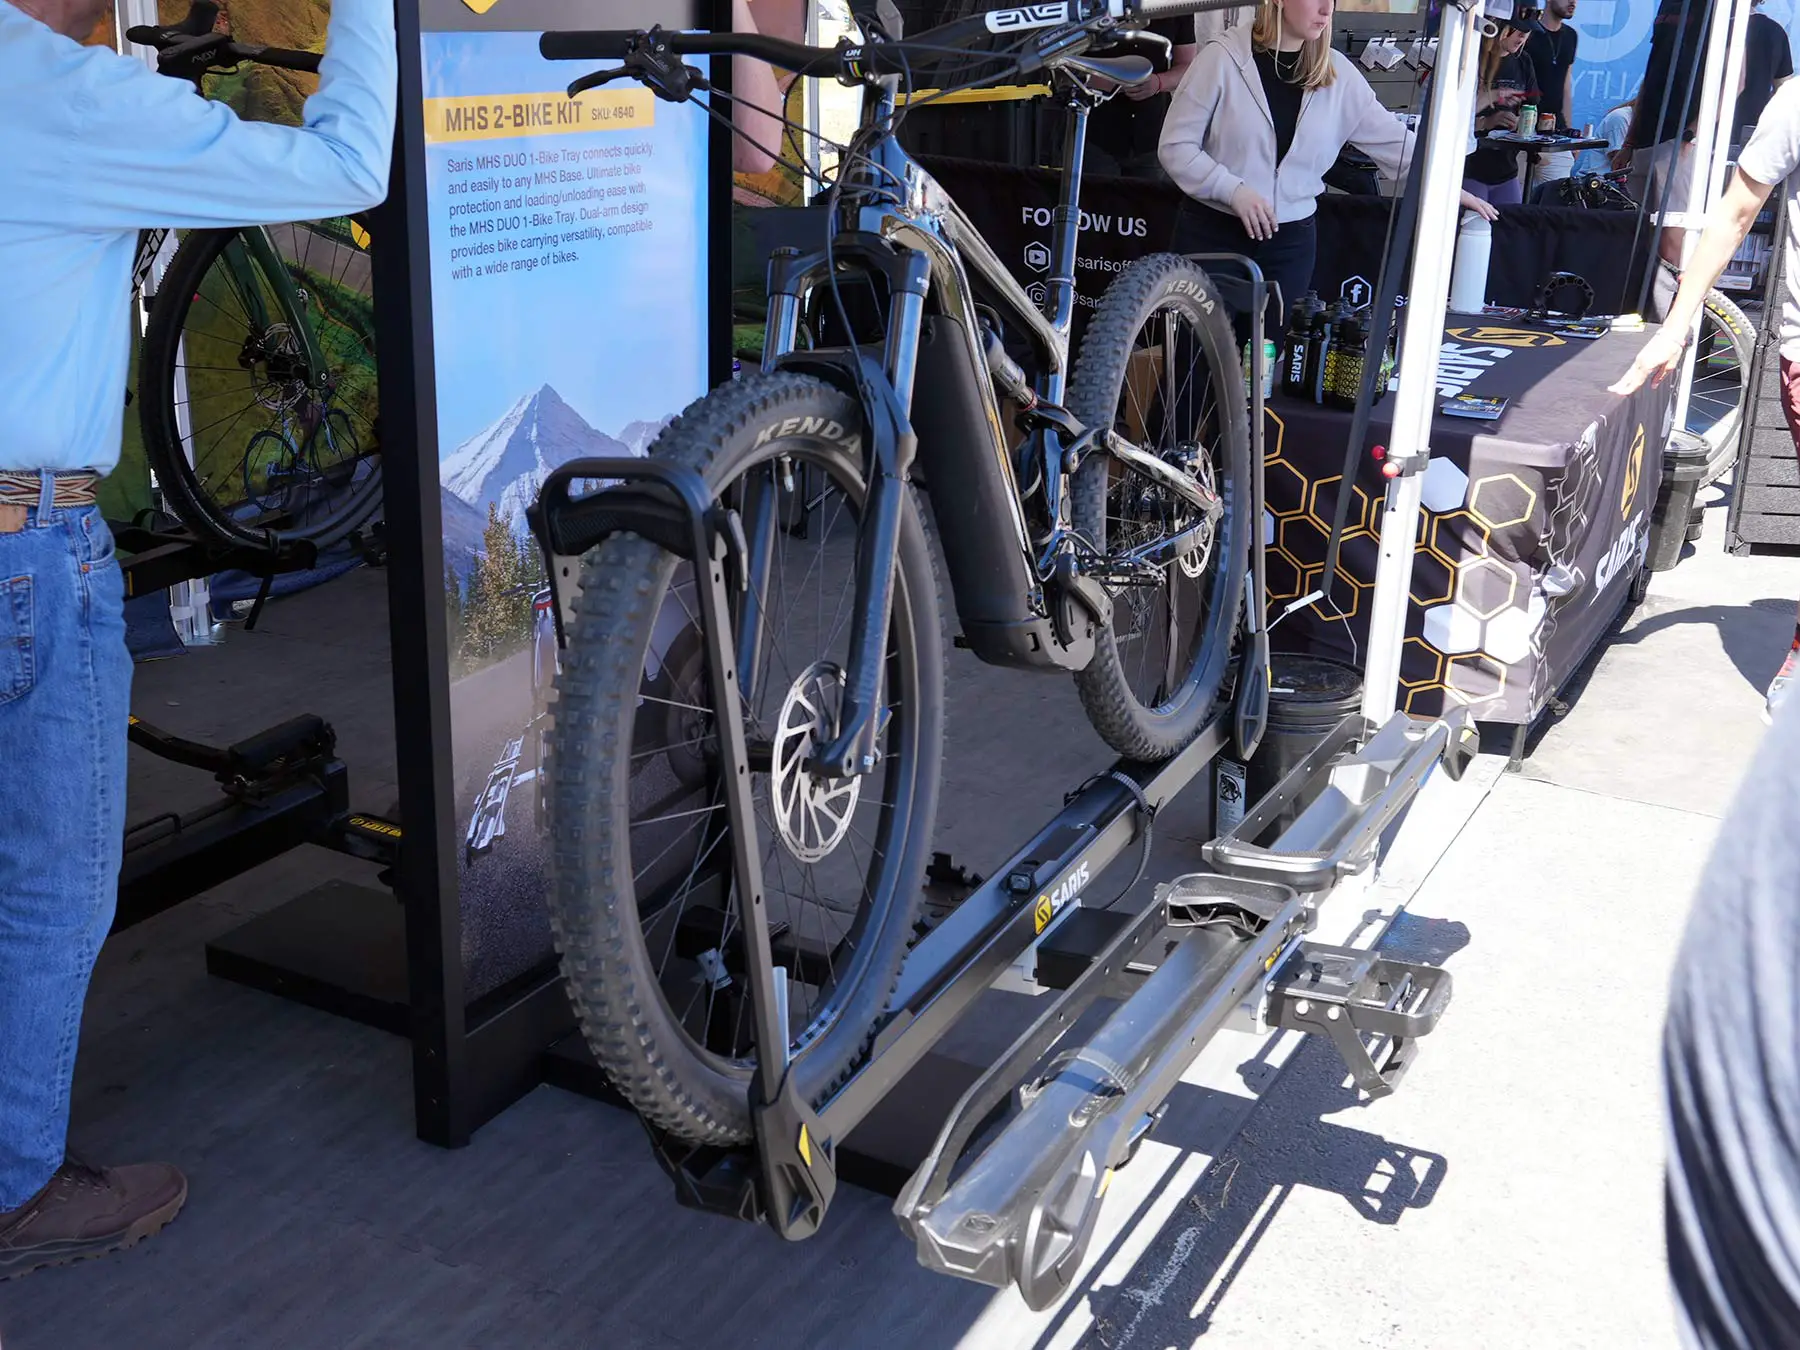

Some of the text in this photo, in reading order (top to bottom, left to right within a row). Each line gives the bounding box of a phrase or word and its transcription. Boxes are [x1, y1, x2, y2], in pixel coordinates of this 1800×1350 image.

[445, 106, 489, 132] MHS
[493, 102, 553, 129] 2-BIKE
[557, 101, 583, 124] KIT
[591, 107, 612, 121] SKU:
[447, 158, 474, 173] Saris
[476, 154, 501, 170] MHS
[503, 152, 527, 168] DUO
[529, 150, 559, 166] 1-Bike
[560, 149, 581, 163] Tray
[582, 145, 622, 160] connects
[448, 163, 641, 195] and easily to any MHS Base. Ultimate bike
[449, 181, 647, 220] protection and loading/unloading ease with
[450, 201, 649, 238] the MHS DUO 1-Bike Tray. Dual-arm design
[1022, 207, 1148, 237] FOOW US
[451, 219, 653, 262] provides bike carrying versatility, compatible
[451, 249, 579, 280] with a wide range of bikes.
[1163, 279, 1216, 315] KENDA
[1290, 344, 1305, 383] SARIS
[753, 416, 862, 454] KENDA
[1051, 861, 1090, 915] SARIS
